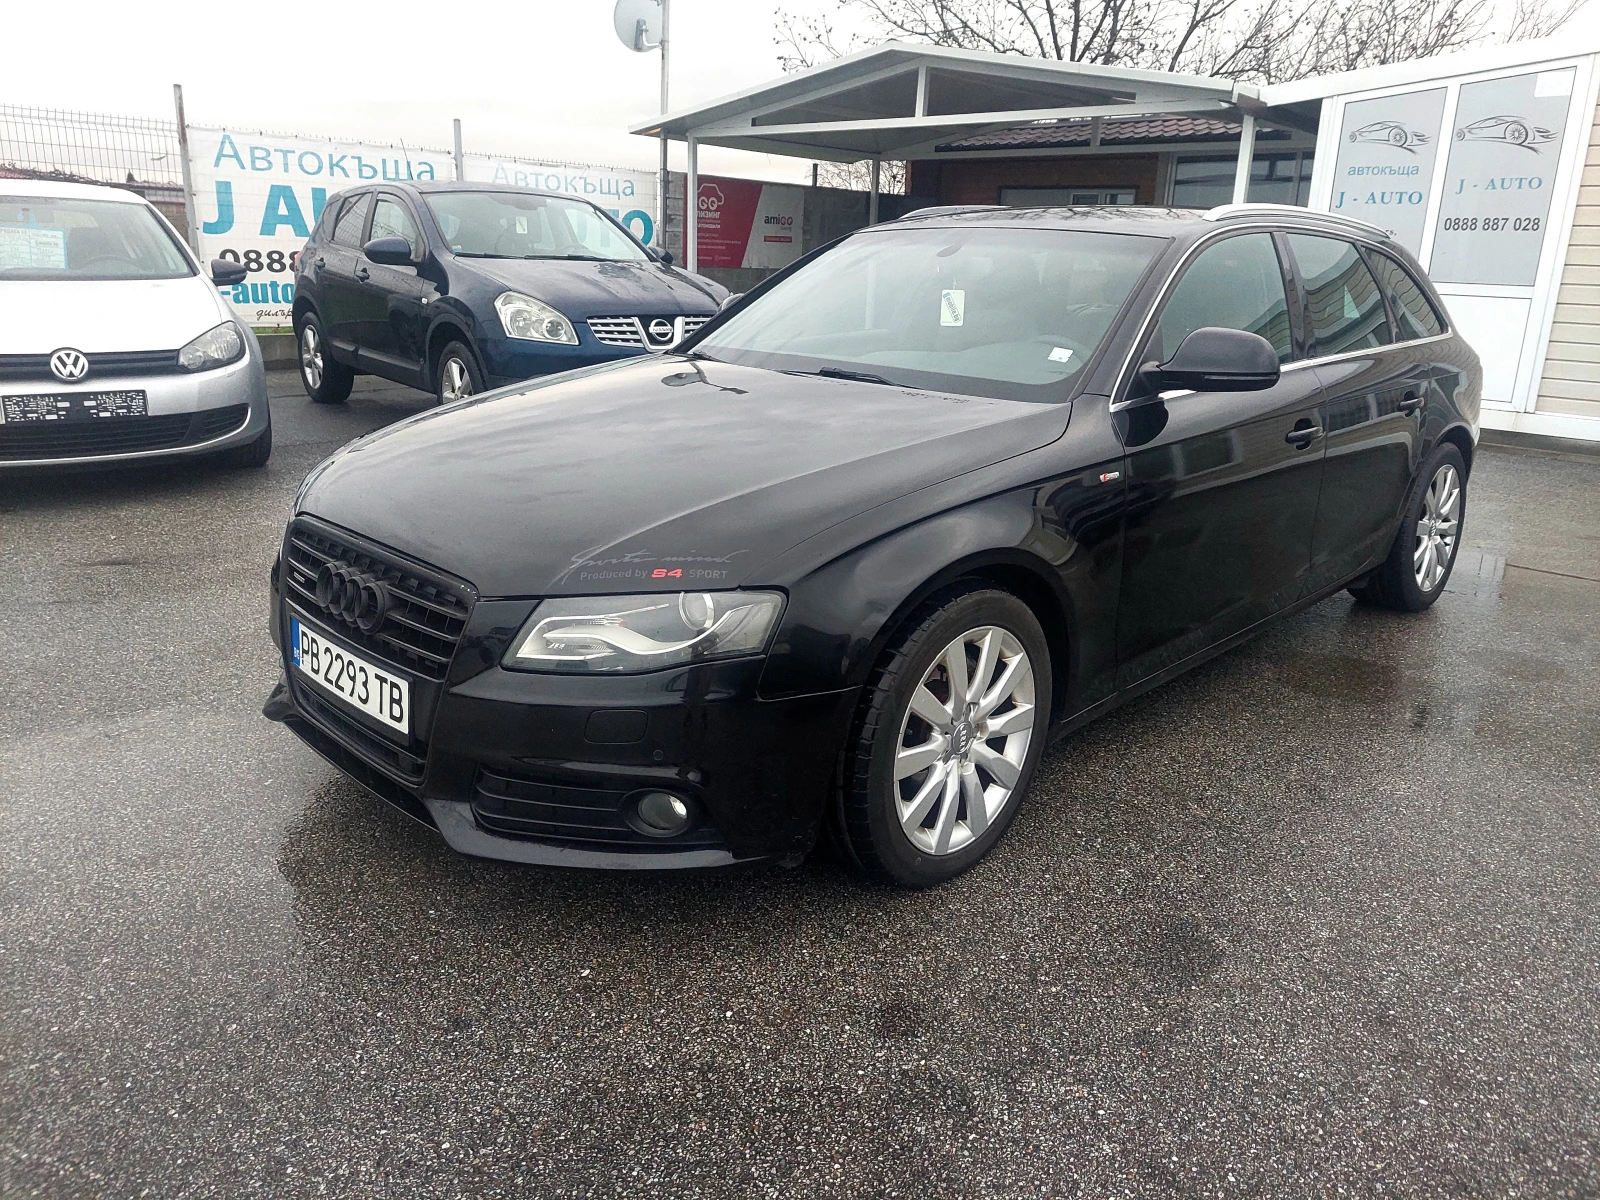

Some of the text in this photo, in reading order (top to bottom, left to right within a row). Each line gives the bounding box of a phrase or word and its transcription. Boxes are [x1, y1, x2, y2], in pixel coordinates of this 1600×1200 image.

[213, 133, 435, 181] Автокъща
[1348, 165, 1420, 178] автокъща
[492, 163, 635, 200] Автокъща
[1454, 178, 1466, 195] J
[1484, 176, 1543, 191] AUTO
[202, 180, 235, 235] J
[1335, 191, 1346, 209] J
[1364, 191, 1423, 205] AUTO
[1444, 217, 1541, 231] 0888 887 028
[580, 568, 728, 580] Produced by S4 SPORT
[323, 645, 370, 705] 2293
[374, 672, 404, 724] TB
